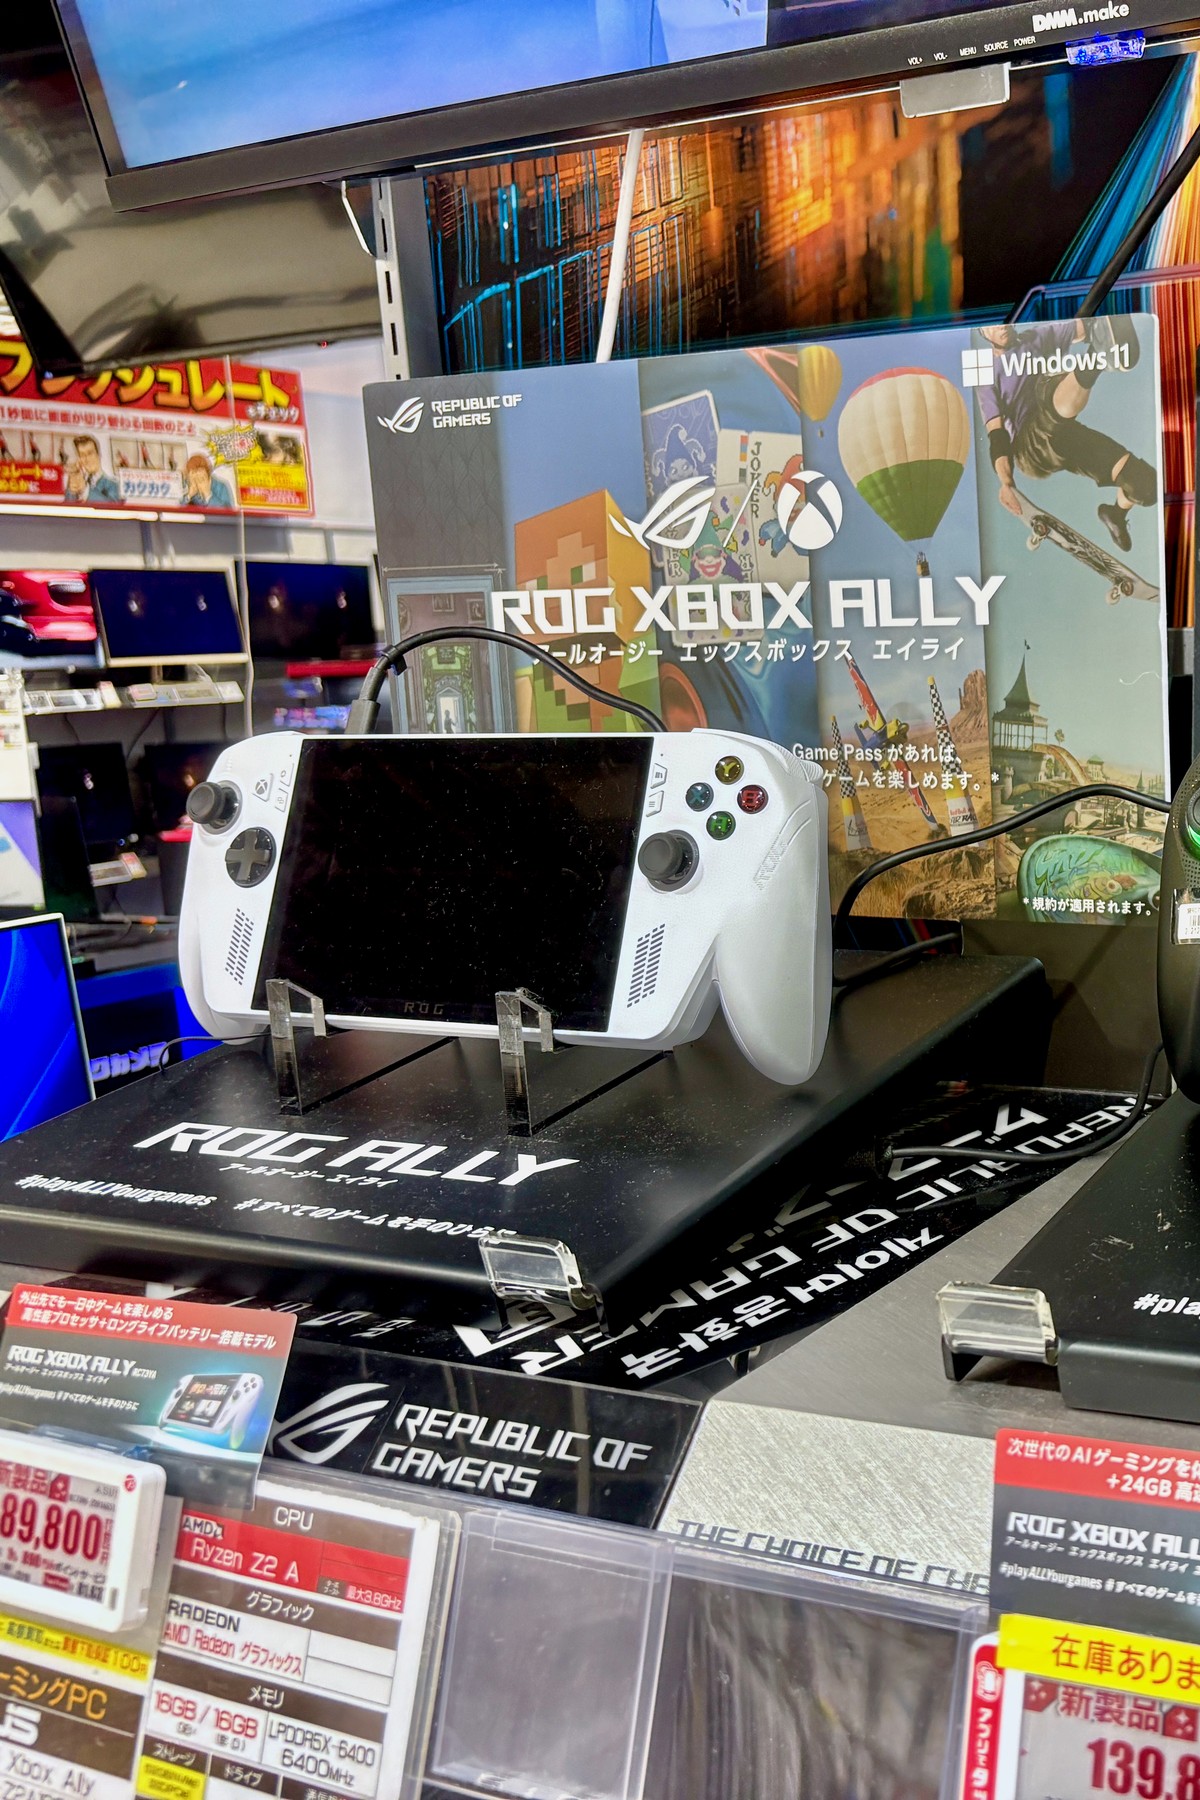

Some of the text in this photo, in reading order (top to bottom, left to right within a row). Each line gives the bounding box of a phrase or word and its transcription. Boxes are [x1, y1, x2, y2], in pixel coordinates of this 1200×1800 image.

[1032, 1, 1130, 33] DMM.make
[907, 35, 1036, 66] VOL+ VOL- MENU SOURCE POWER
[1001, 343, 1131, 378] Windows 11
[431, 393, 523, 414] REPUBLIC OF
[432, 412, 492, 430] GAMERS
[490, 575, 1008, 636] ROG XBOX ALLY
[680, 638, 853, 663] エックスボックス
[872, 636, 965, 662] エイライ
[792, 743, 963, 763] Game Pass があれば、
[720, 761, 740, 780] Y
[822, 768, 984, 792] ゲームを楽しめます。
[741, 790, 764, 808] B
[711, 817, 730, 835] A
[1032, 896, 1153, 917] 規約が適用されます。
[403, 1001, 444, 1017] ROG
[133, 1122, 581, 1187] ROG ALLY
[15, 1173, 217, 1207] #playALLYourgames
[7, 1344, 46, 1365] ROG
[46, 1348, 92, 1372] XBOX
[91, 1354, 137, 1379] ALLY
[396, 1402, 653, 1473] REPUBLIC OF
[372, 1440, 538, 1500] GAMERS
[273, 1506, 315, 1531] CPU
[1006, 1512, 1067, 1539] ROG
[1070, 1519, 1149, 1553] XBOX
[190, 1538, 300, 1584] Ryzen Z2 A
[677, 1518, 741, 1545] THE
[744, 1531, 866, 1569] CHOICE
[868, 1554, 919, 1580] OF
[999, 1560, 1103, 1592] #playALLYourgames
[168, 1597, 241, 1633] RADEON
[246, 1590, 316, 1622] グラフィック
[163, 1621, 303, 1677] AMD Radeon グラフィックス
[248, 1684, 286, 1709] メモリ
[1058, 1684, 1163, 1734] 新製品
[153, 1690, 198, 1722] 16GB
[213, 1708, 260, 1740] 16GB
